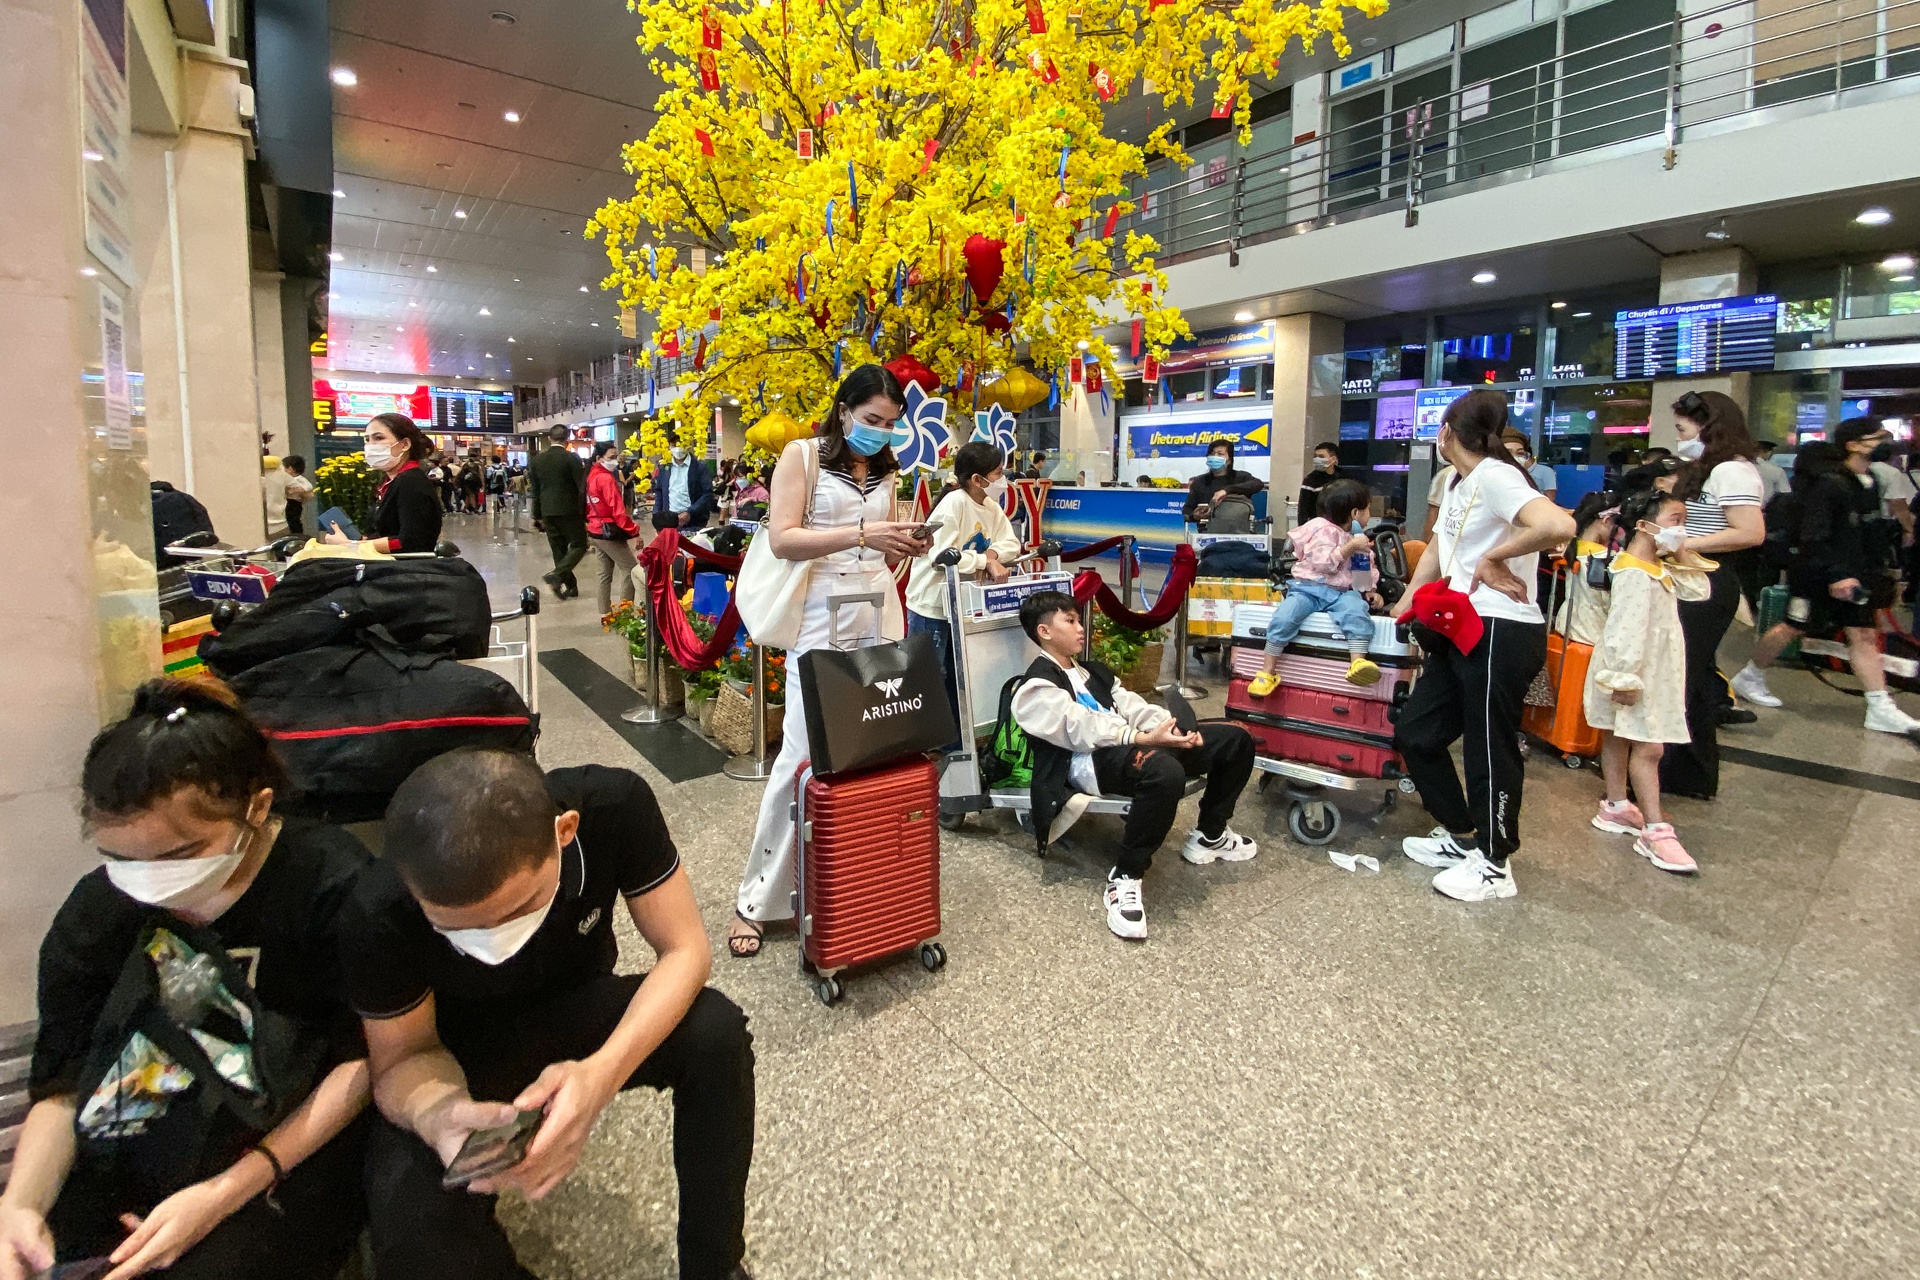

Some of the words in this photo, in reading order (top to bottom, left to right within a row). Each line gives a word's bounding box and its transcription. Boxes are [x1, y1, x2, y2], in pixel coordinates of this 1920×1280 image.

[1754, 295, 1776, 304] 19:50
[1628, 308, 1659, 320] Chuyến
[1675, 301, 1723, 314] Departures
[1227, 332, 1255, 344] Airlines
[1149, 432, 1197, 446] Vietravel
[1196, 430, 1242, 446] Airlines
[1242, 444, 1258, 452] World
[1045, 498, 1081, 510] ELCOME!
[207, 581, 231, 595] BIDV
[862, 697, 922, 722] ARISTINO
